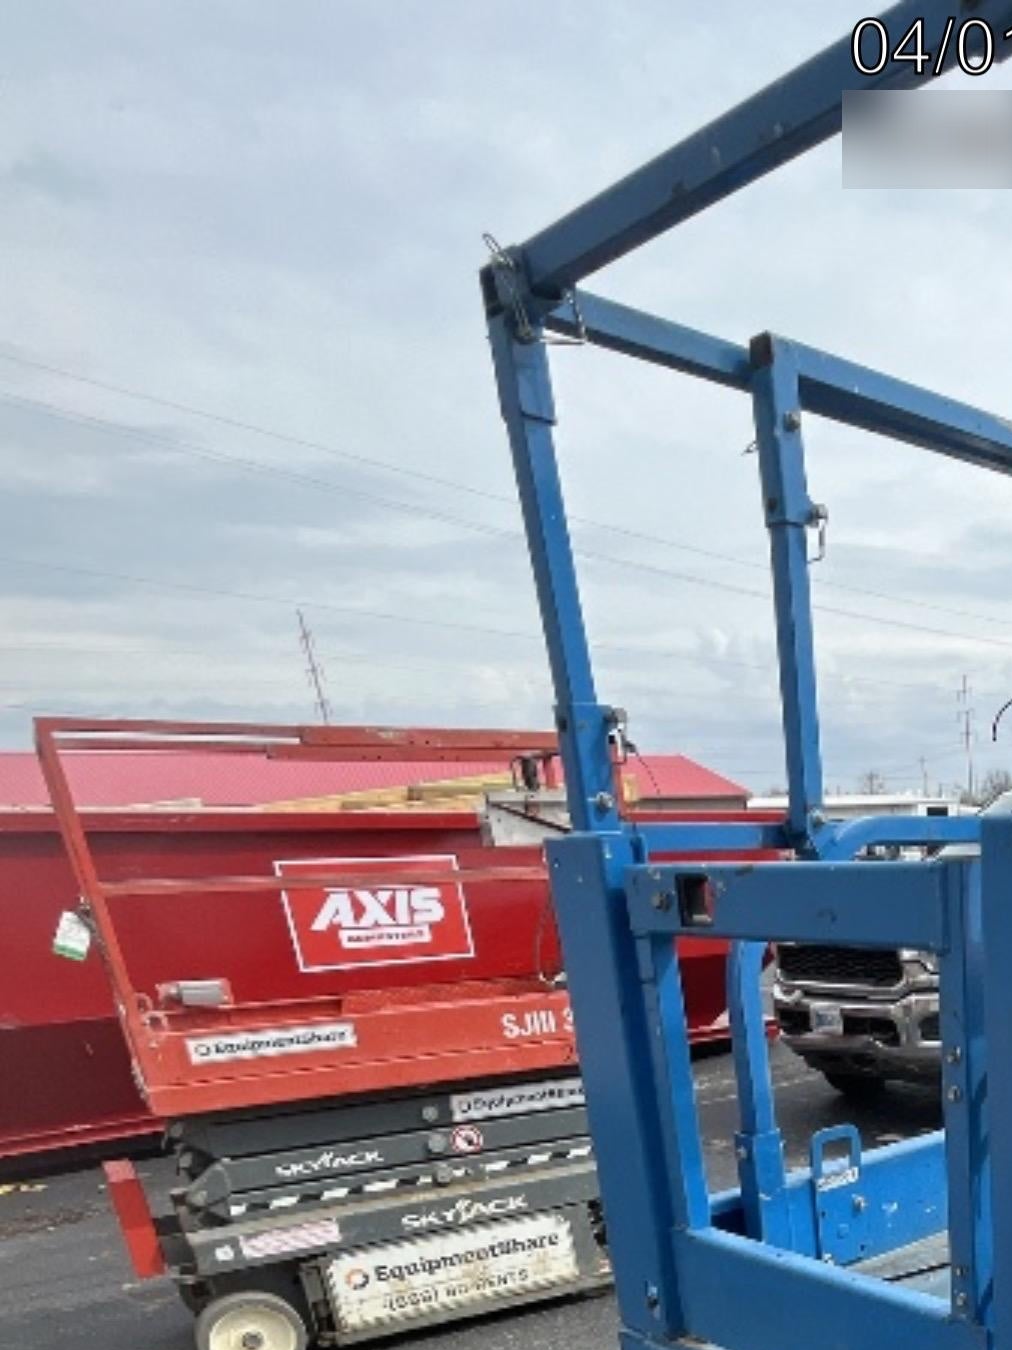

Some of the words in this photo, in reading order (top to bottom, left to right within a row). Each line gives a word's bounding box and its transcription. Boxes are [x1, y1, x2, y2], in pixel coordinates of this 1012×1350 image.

[310, 886, 445, 931] AXIS
[401, 1193, 529, 1230] SKYJACK
[374, 1234, 559, 1282] EquipmentShare
